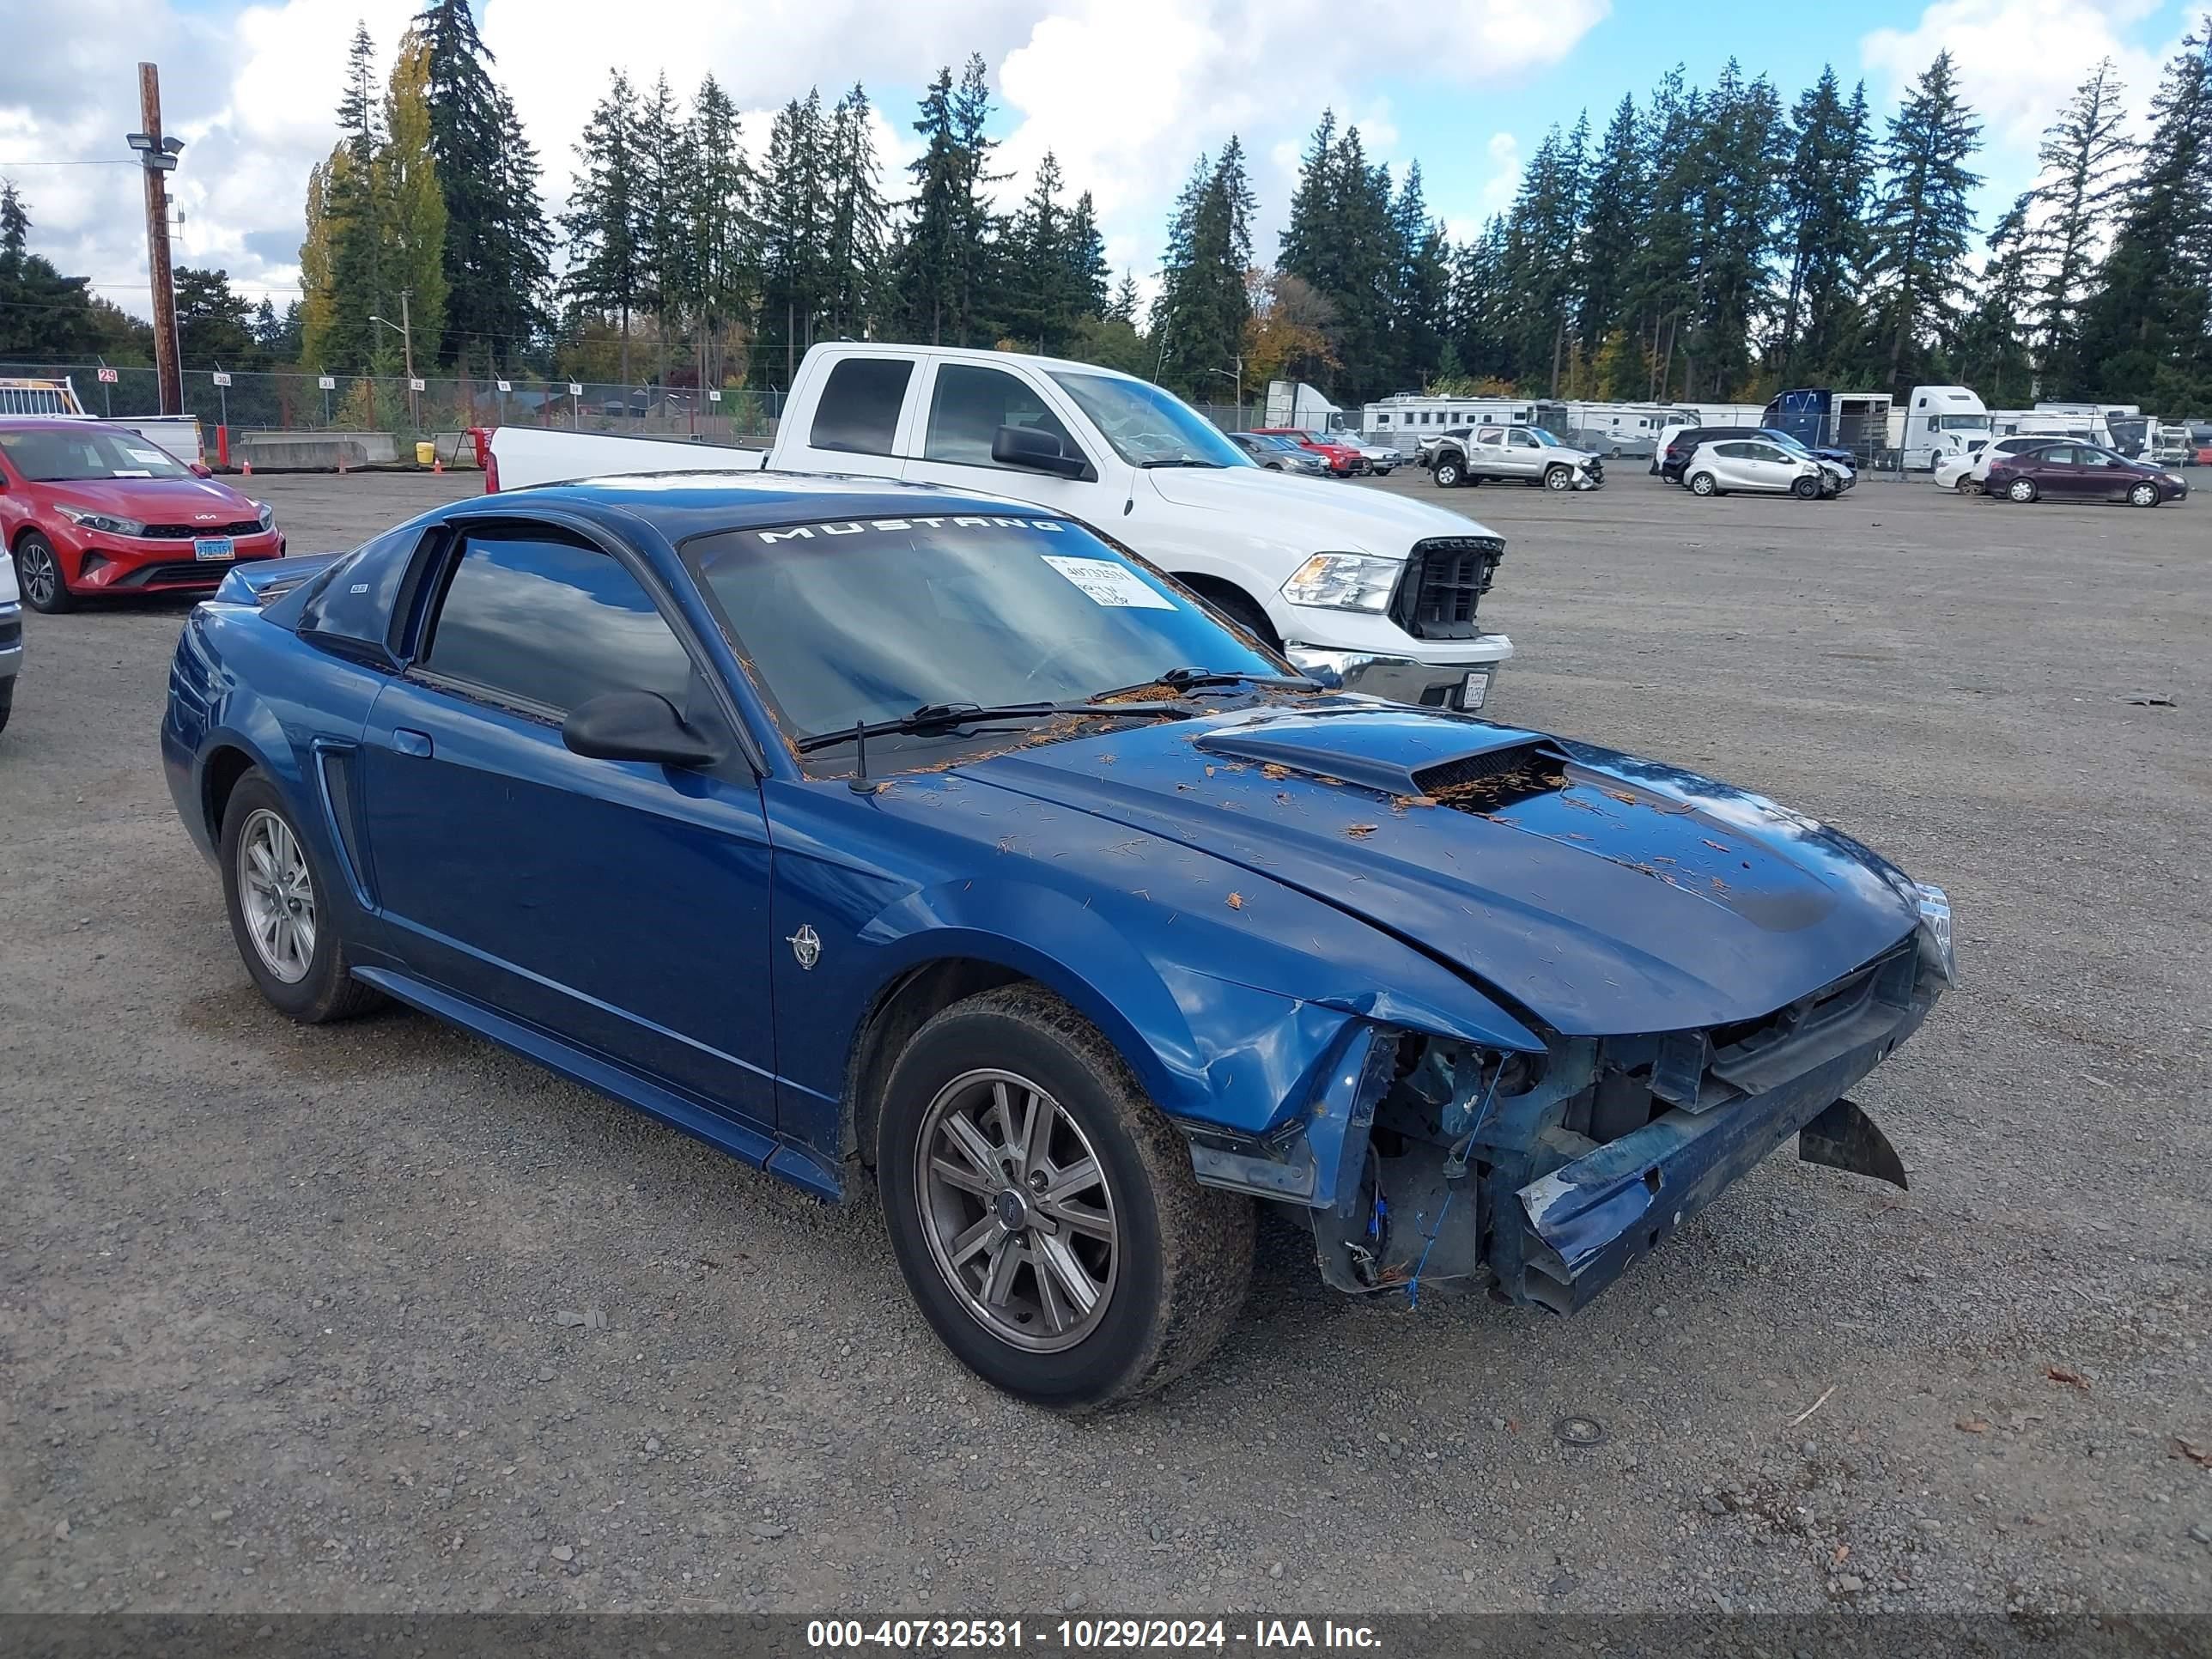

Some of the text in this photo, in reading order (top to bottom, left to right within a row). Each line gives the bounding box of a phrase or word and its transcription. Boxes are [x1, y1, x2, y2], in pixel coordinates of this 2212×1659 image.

[100, 369, 117, 381] 29
[757, 517, 1066, 544] MUSTANG
[1067, 567, 1131, 581] 40732531
